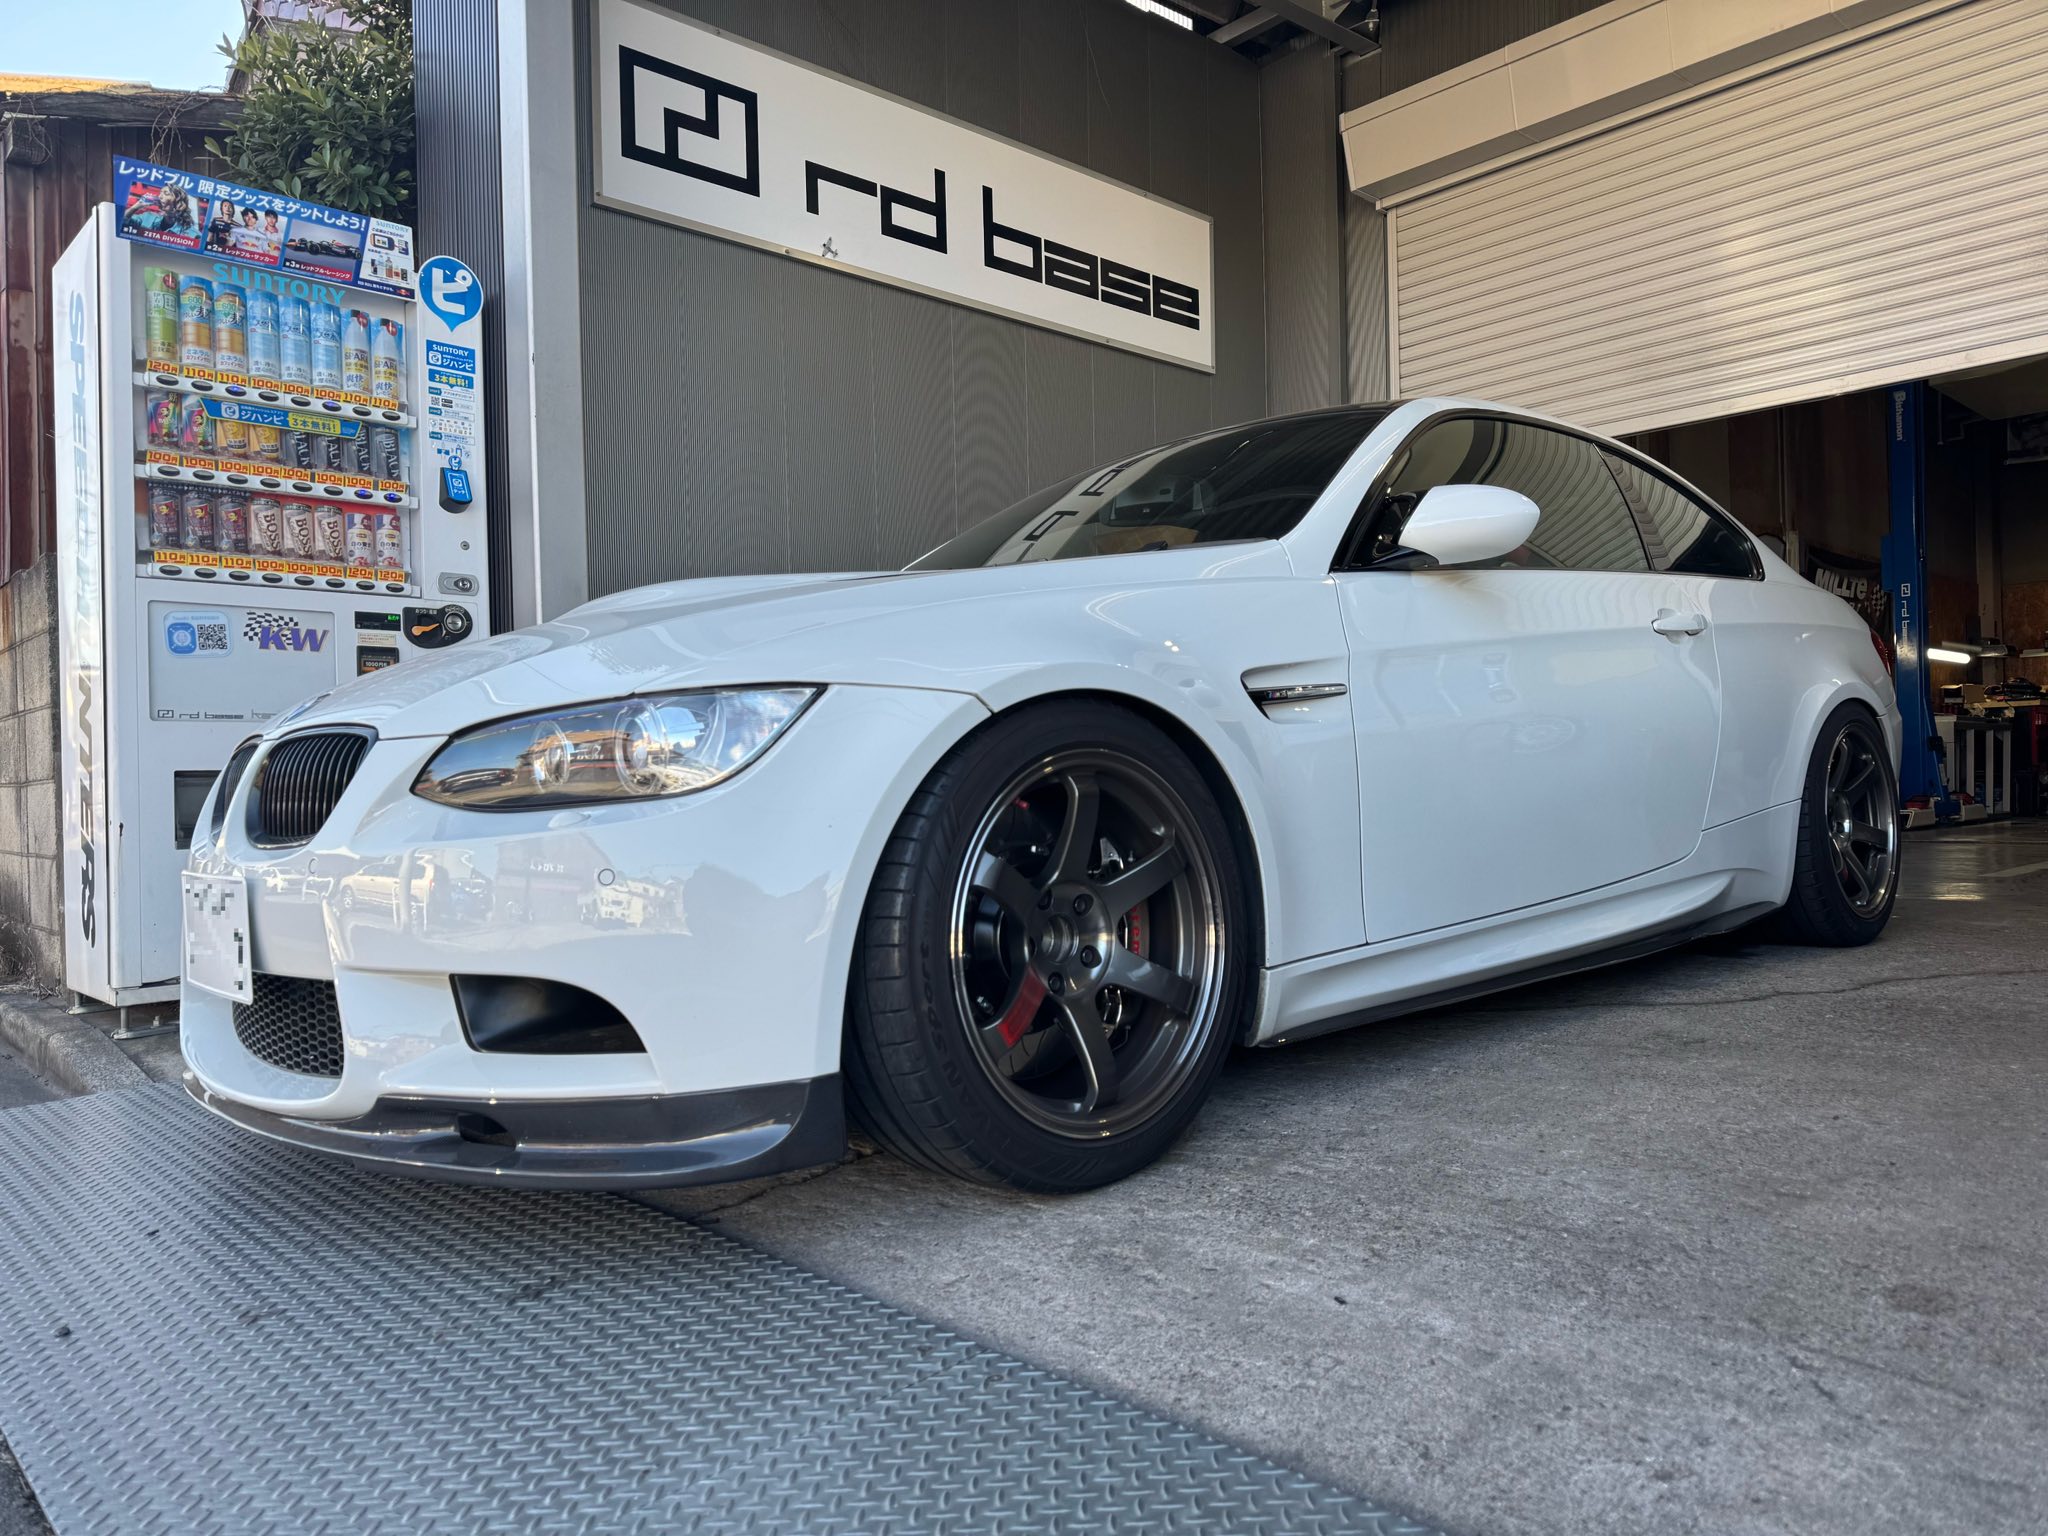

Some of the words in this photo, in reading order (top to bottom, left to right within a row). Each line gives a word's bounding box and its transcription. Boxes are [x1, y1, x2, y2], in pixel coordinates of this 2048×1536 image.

[119, 161, 194, 189] レッドブル
[198, 179, 367, 231] 限定グッズをゲットしよう!
[144, 230, 161, 239] ZETA
[162, 233, 194, 246] DIVISION
[805, 160, 948, 255] rd
[982, 185, 1200, 331] base
[212, 262, 346, 305] SUNTORY
[433, 344, 469, 357] SUNTORY
[442, 358, 474, 371] ジハンピ
[240, 409, 285, 425] ジハンピ
[326, 436, 342, 467] LACK
[382, 434, 400, 478] BLACK
[263, 513, 283, 551] BOSS
[295, 518, 313, 554] BOSS
[326, 519, 344, 556] BOSS
[259, 626, 330, 652] KW
[179, 711, 200, 719] rd
[204, 711, 244, 719] base
